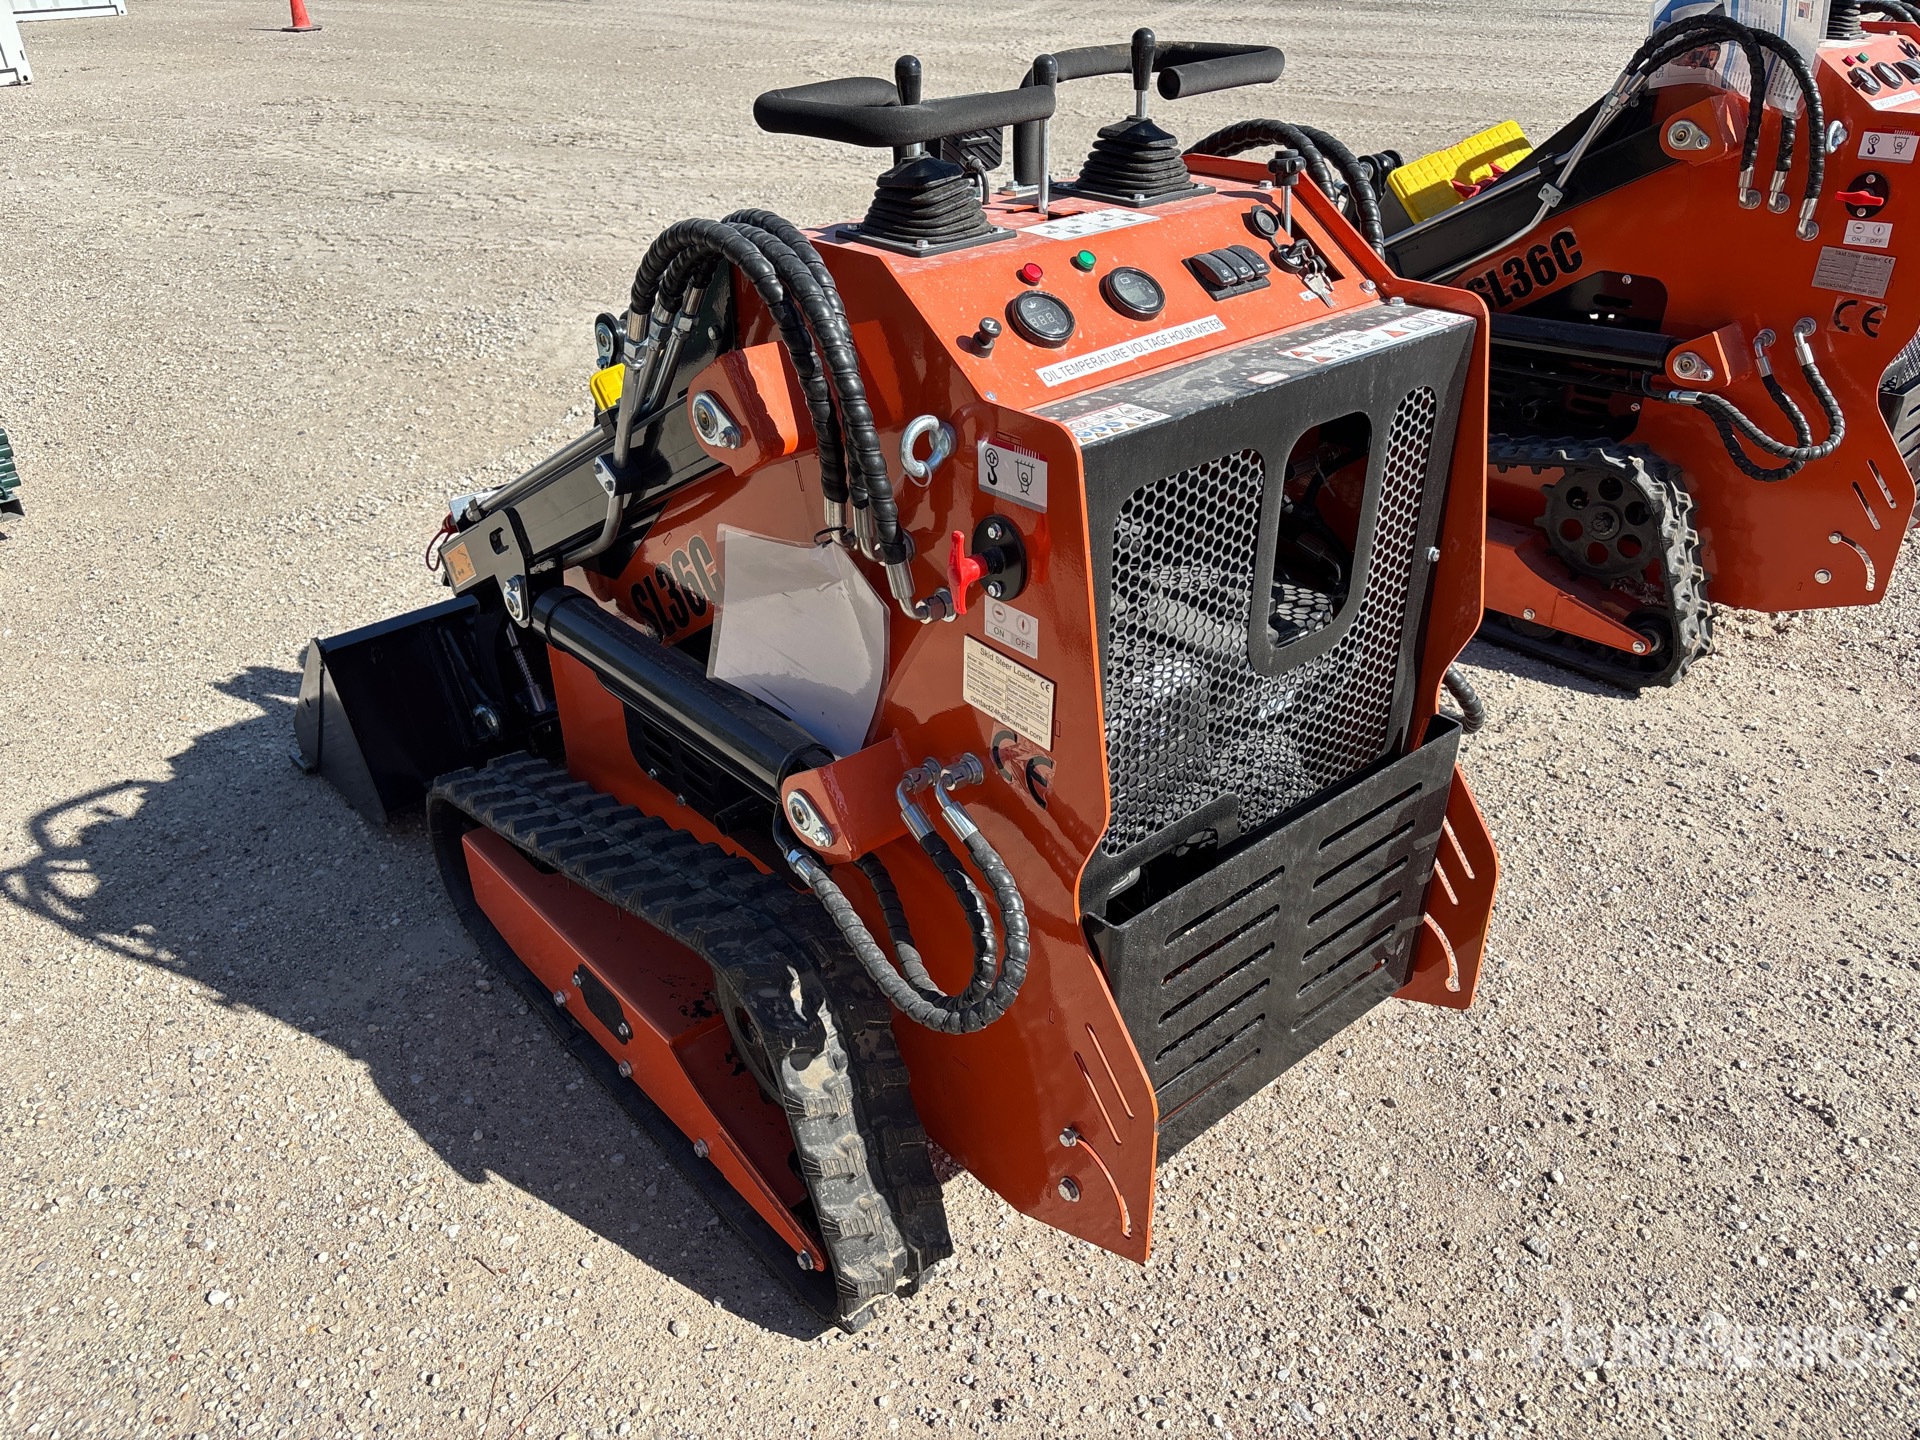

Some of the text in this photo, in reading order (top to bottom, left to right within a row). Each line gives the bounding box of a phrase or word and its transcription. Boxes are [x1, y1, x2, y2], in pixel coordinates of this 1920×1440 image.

[1465, 231, 1583, 312] SL36C
[1042, 318, 1225, 383] OIL TEMPERATURE VOLTAGE HOUR METER
[631, 536, 724, 643] SL36C
[980, 647, 994, 661] Skid
[995, 655, 1012, 670] Steer
[1013, 666, 1036, 684] Loader
[993, 626, 1031, 650] ON OFF
